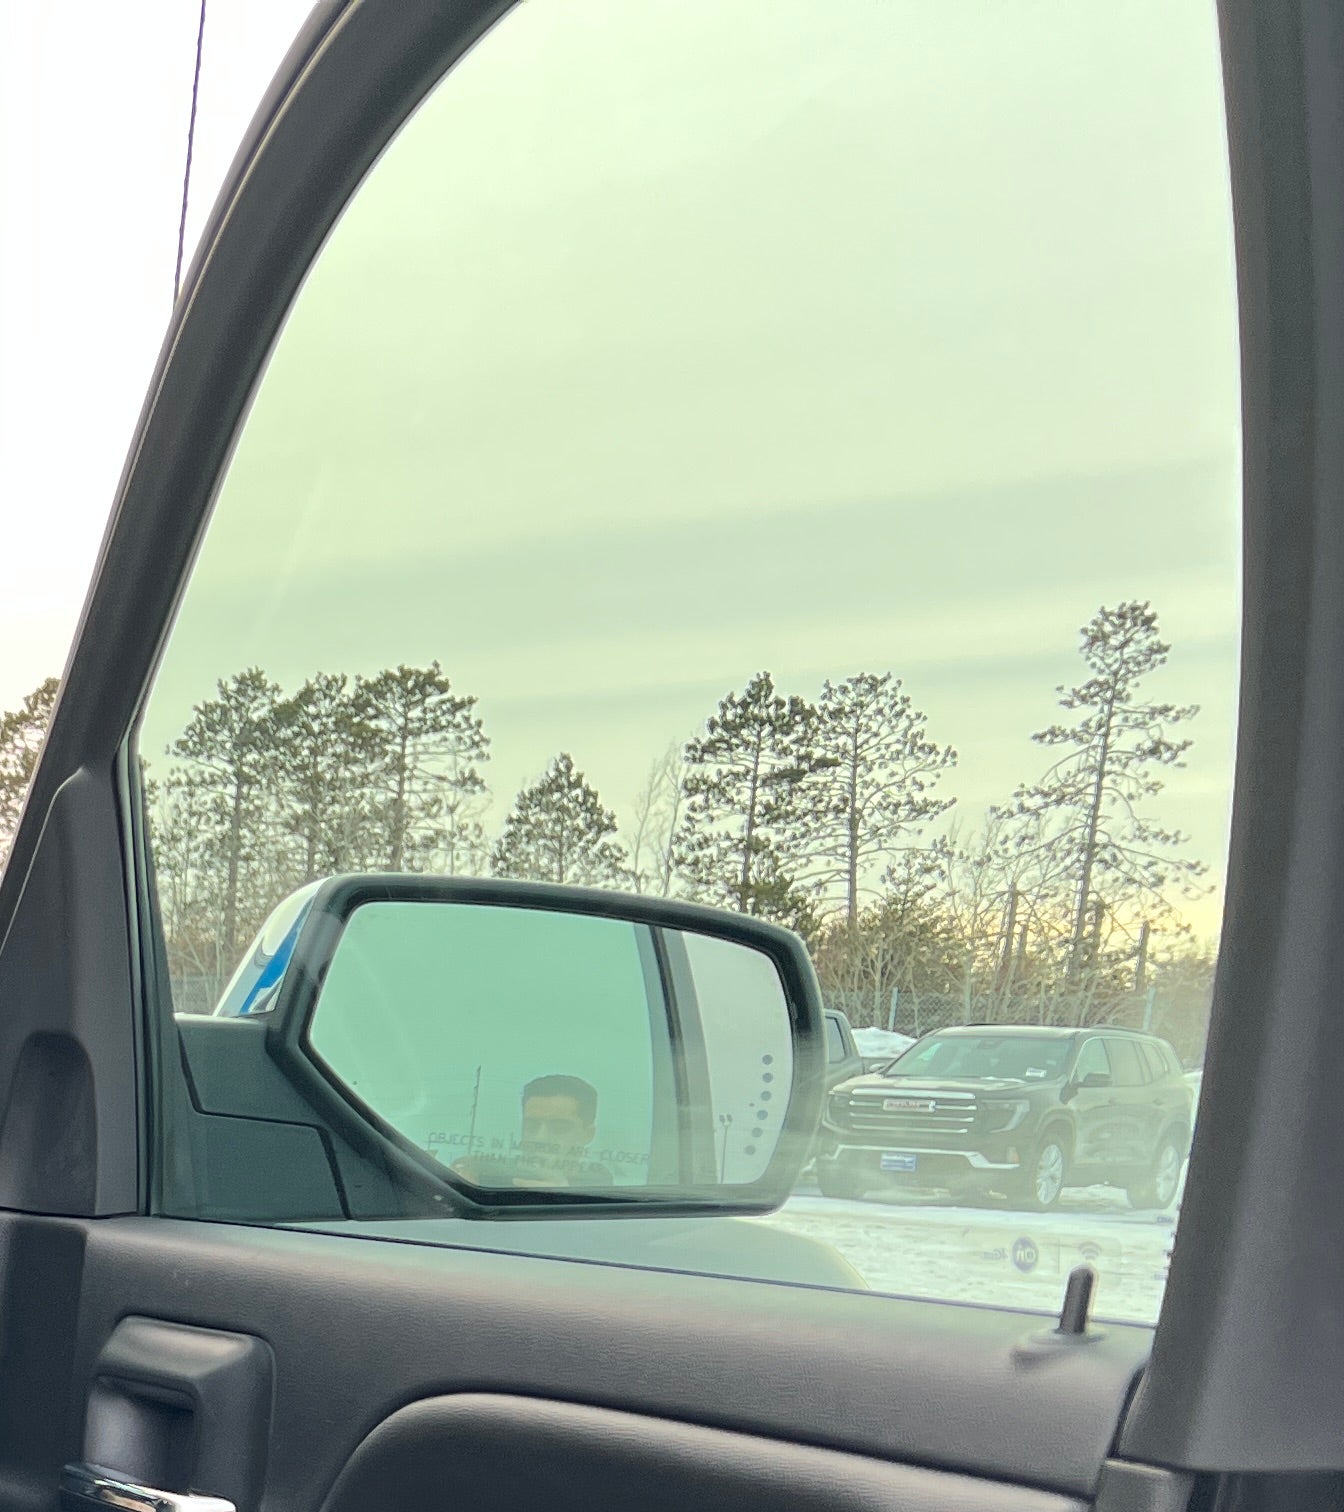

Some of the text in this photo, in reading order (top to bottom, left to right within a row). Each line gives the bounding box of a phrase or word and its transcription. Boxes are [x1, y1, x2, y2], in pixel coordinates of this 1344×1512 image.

[428, 1131, 485, 1148] OBJECTS
[491, 1137, 504, 1149] IN
[600, 1149, 650, 1165] CLOSER
[473, 1150, 506, 1164] THAN
